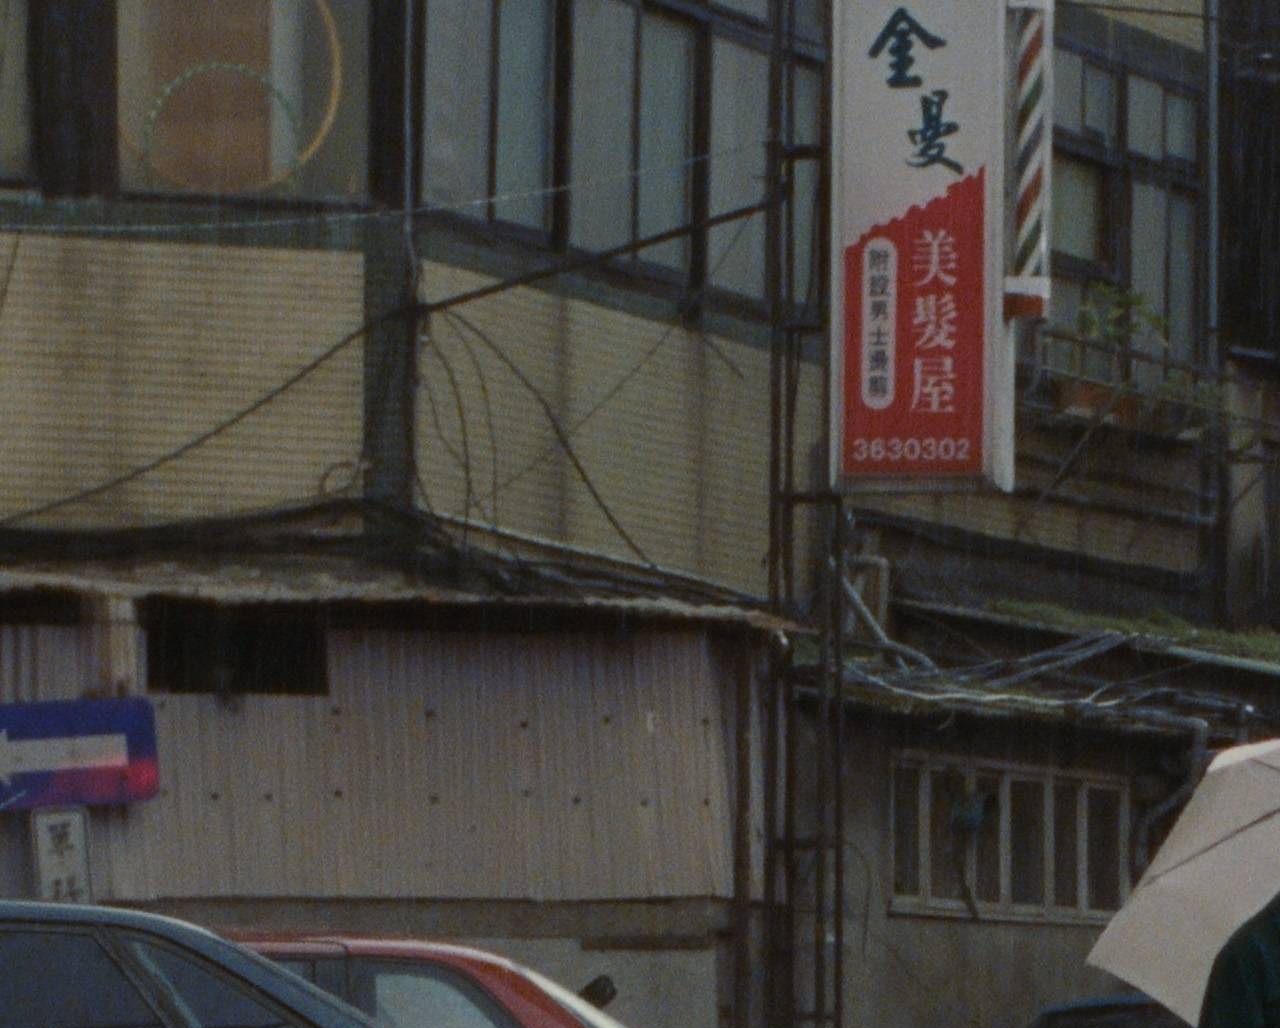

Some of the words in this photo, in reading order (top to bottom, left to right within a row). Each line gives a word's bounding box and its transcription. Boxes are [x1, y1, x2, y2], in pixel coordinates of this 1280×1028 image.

[911, 229, 958, 414] 美髮屋
[852, 437, 971, 461] 3630302
